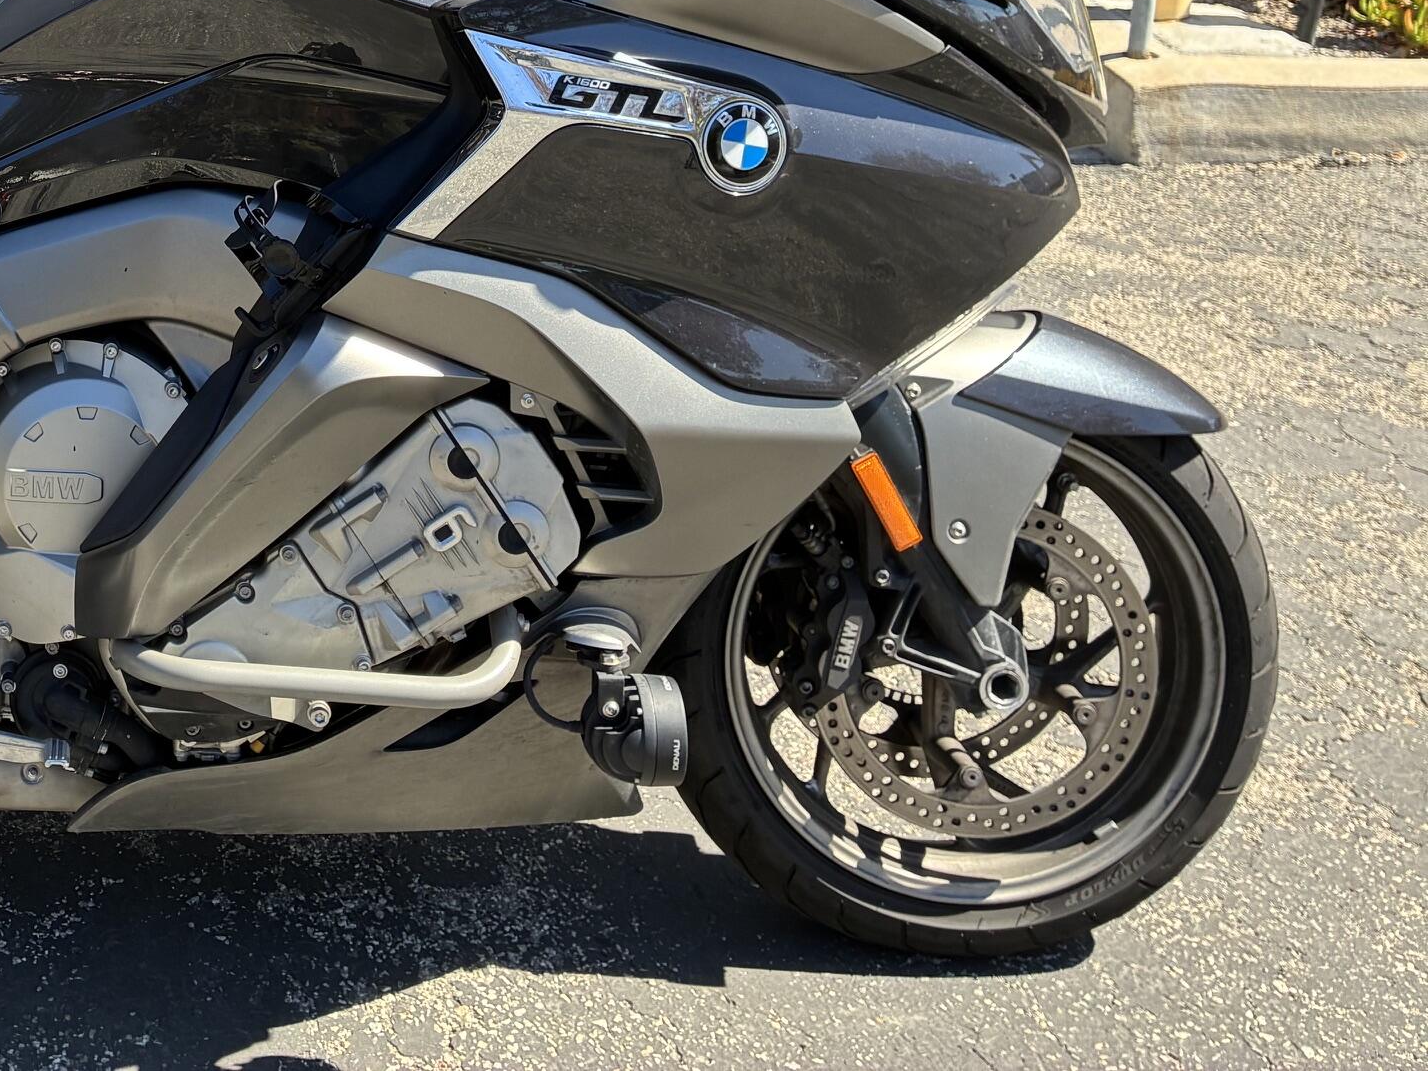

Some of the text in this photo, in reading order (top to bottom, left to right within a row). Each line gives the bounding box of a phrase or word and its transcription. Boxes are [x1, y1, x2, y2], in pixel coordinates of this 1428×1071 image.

[563, 75, 611, 90] K 1600
[549, 75, 686, 123] GTL
[716, 105, 778, 136] BMW
[10, 474, 84, 500] BMW
[834, 619, 859, 669] BMW
[672, 739, 681, 770] DENALI
